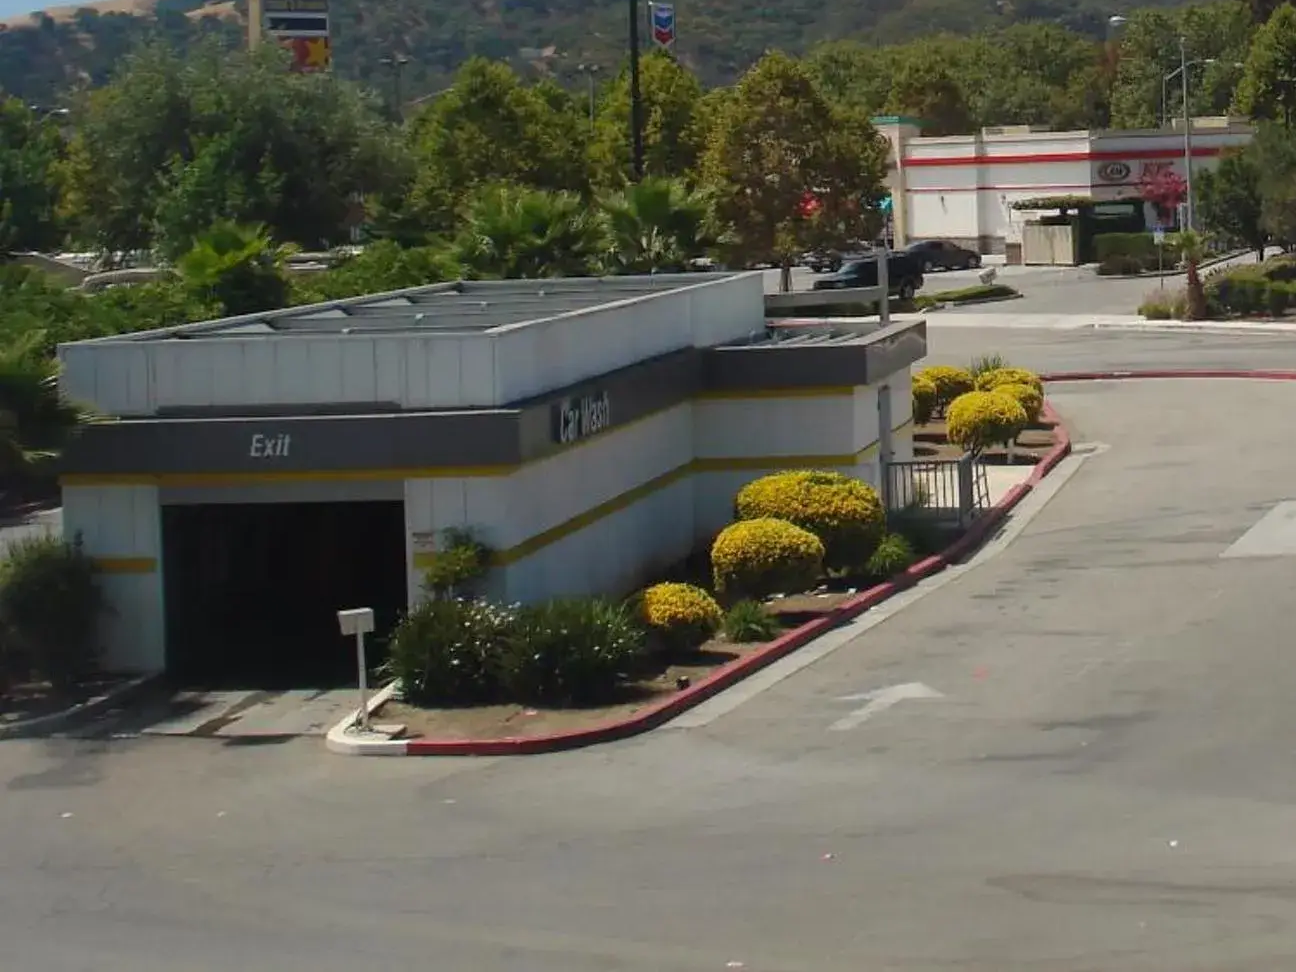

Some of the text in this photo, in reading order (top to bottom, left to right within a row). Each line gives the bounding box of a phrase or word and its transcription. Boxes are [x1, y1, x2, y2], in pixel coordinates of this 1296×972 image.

[560, 391, 610, 443] Car Wash
[250, 433, 291, 457] Exit
